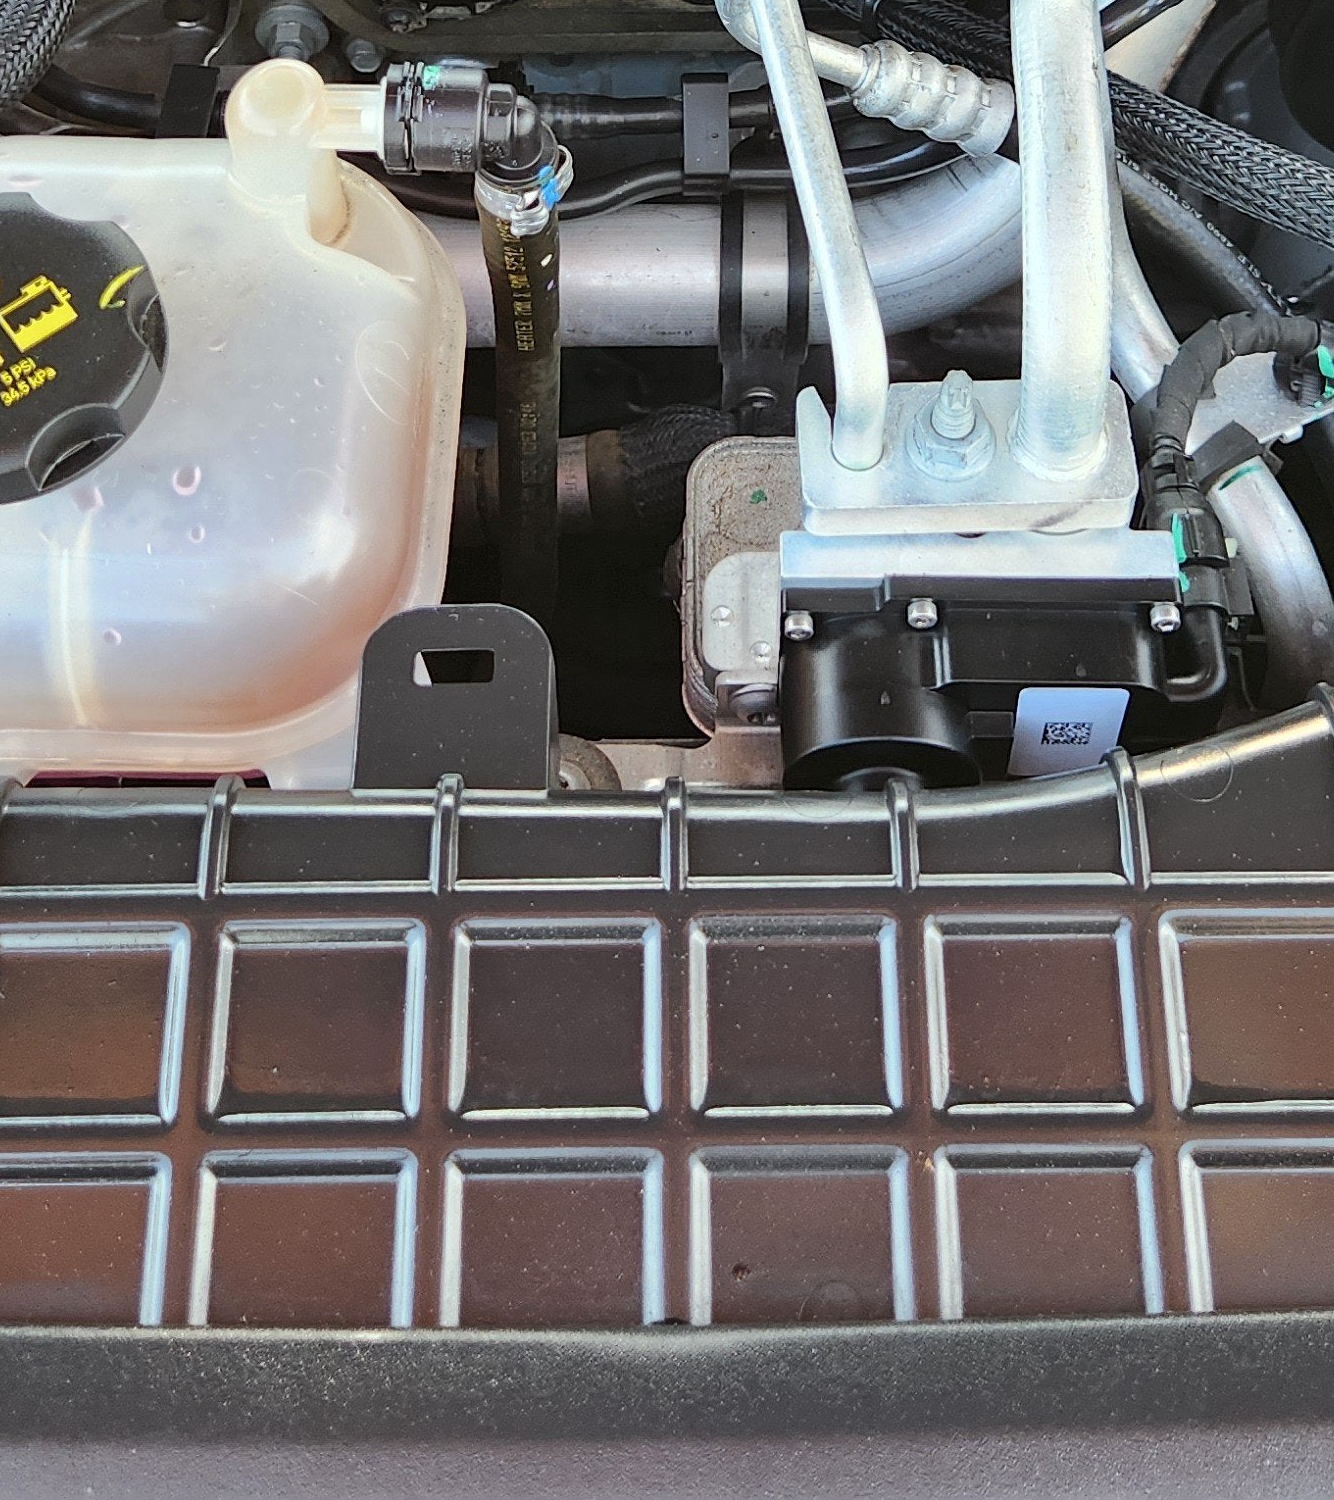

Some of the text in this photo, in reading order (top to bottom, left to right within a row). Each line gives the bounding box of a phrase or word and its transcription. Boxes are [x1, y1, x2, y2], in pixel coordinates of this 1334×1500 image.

[9, 357, 36, 381] PSI
[0, 366, 57, 407] 34.5 kPa
